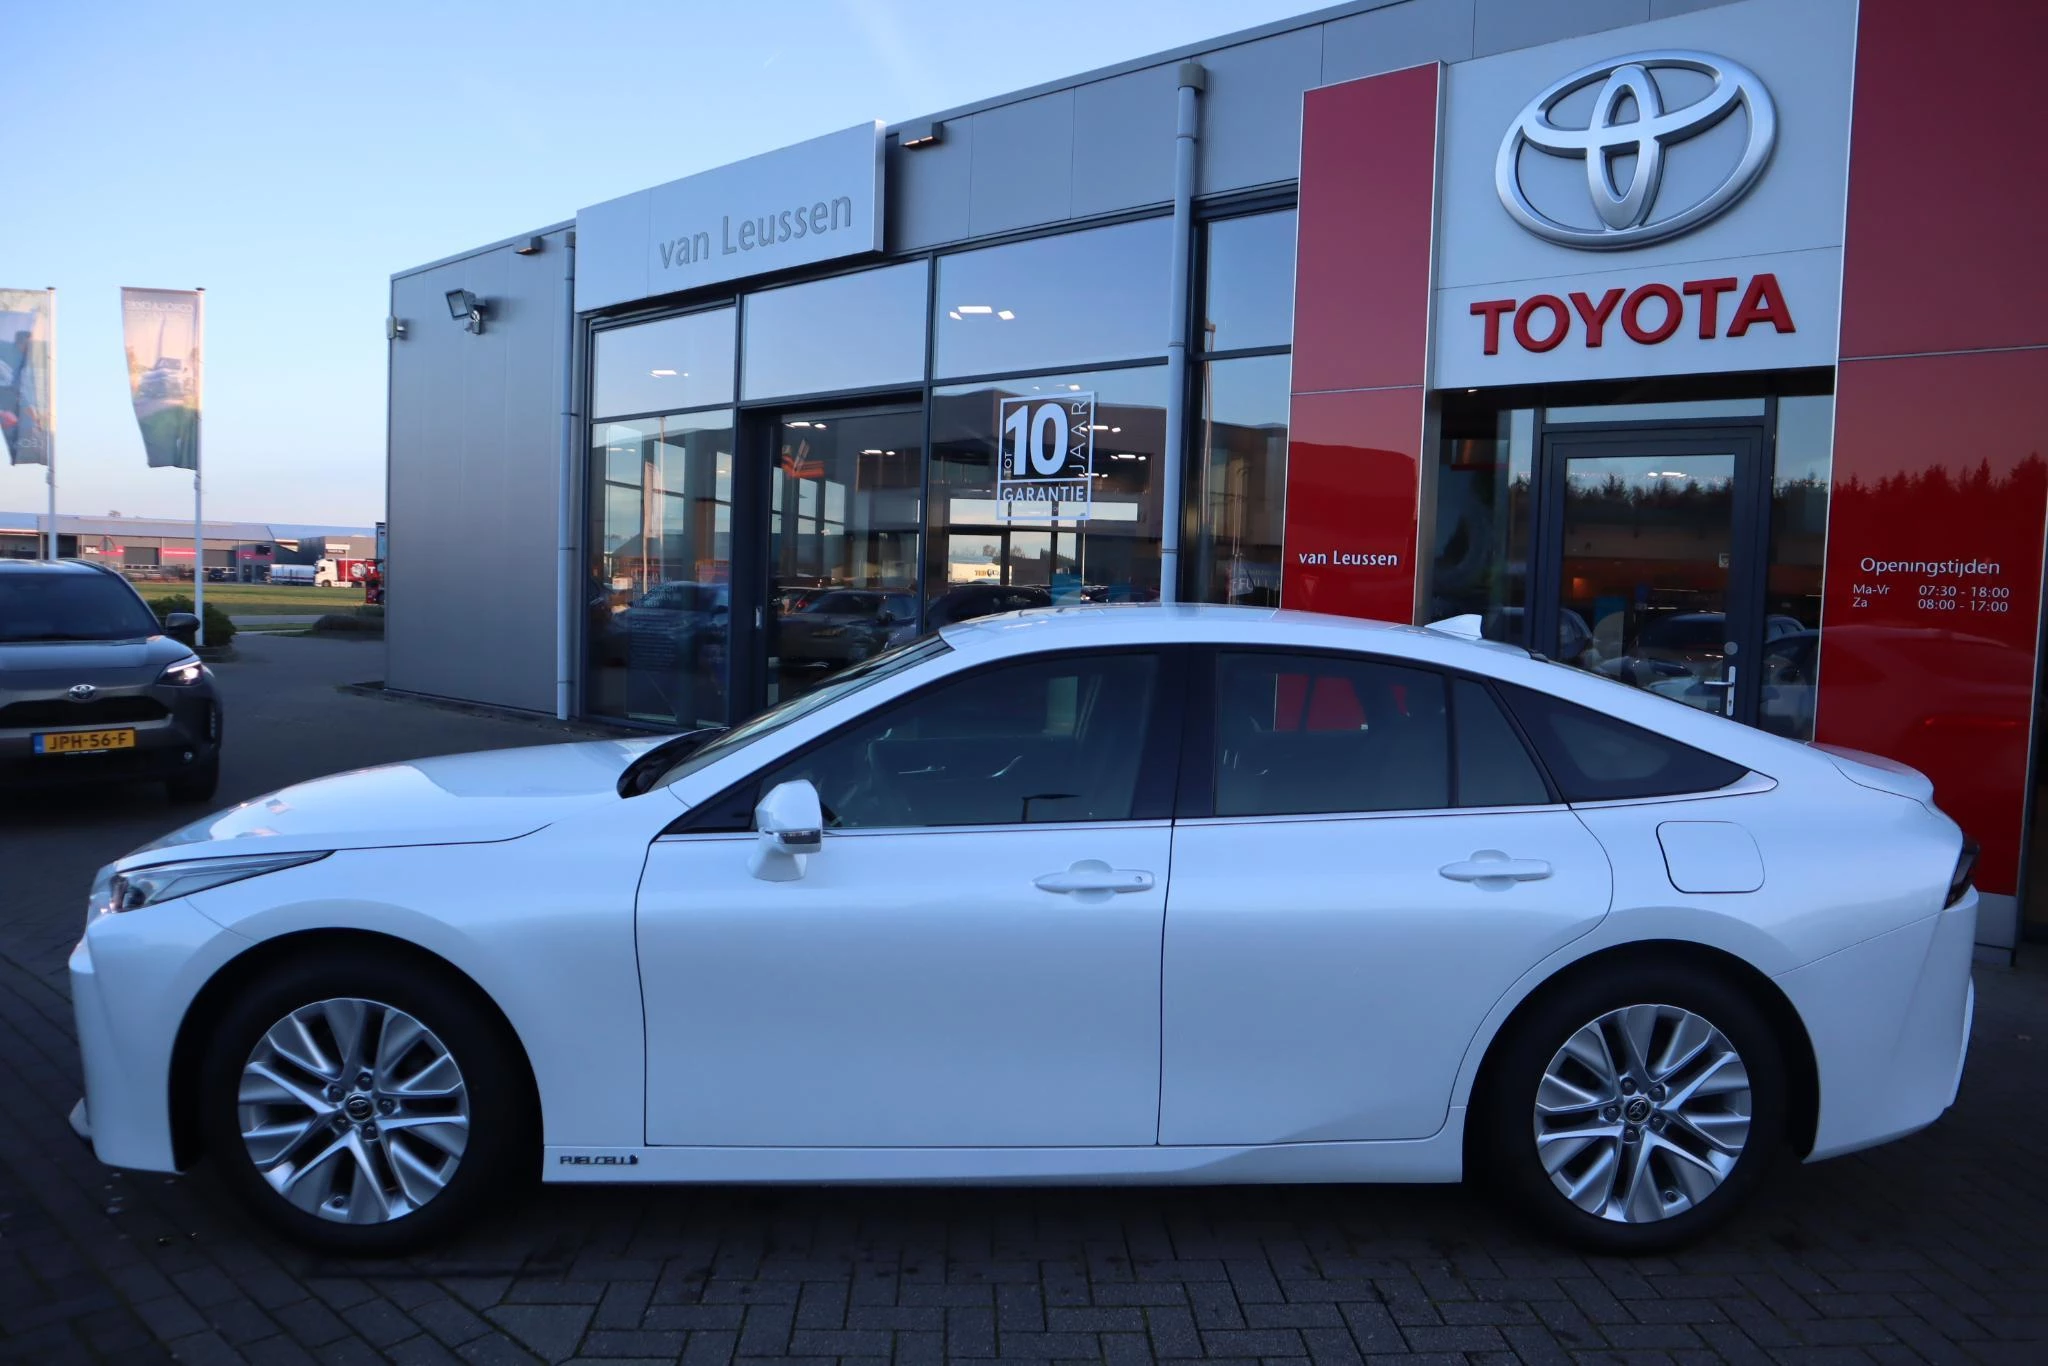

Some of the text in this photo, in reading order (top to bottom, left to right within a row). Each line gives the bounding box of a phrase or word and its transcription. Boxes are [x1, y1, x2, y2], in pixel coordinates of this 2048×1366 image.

[659, 195, 852, 270] van Leussen
[1470, 273, 1796, 356] TOYOTA
[1005, 403, 1068, 476] 10
[1069, 400, 1088, 476] JAAR
[1003, 486, 1084, 502] GARANTIE
[1299, 550, 1398, 566] van Leussen
[1860, 557, 2000, 577] Openingstijden
[1853, 584, 1890, 595] Ma-Vr
[1919, 585, 1957, 597] 07:30
[1971, 586, 2010, 598] 18:00
[1852, 597, 1868, 608] Za
[1918, 599, 1956, 610] 08:00
[1970, 600, 2009, 612] 17:00
[49, 732, 127, 750] JPH-56-F
